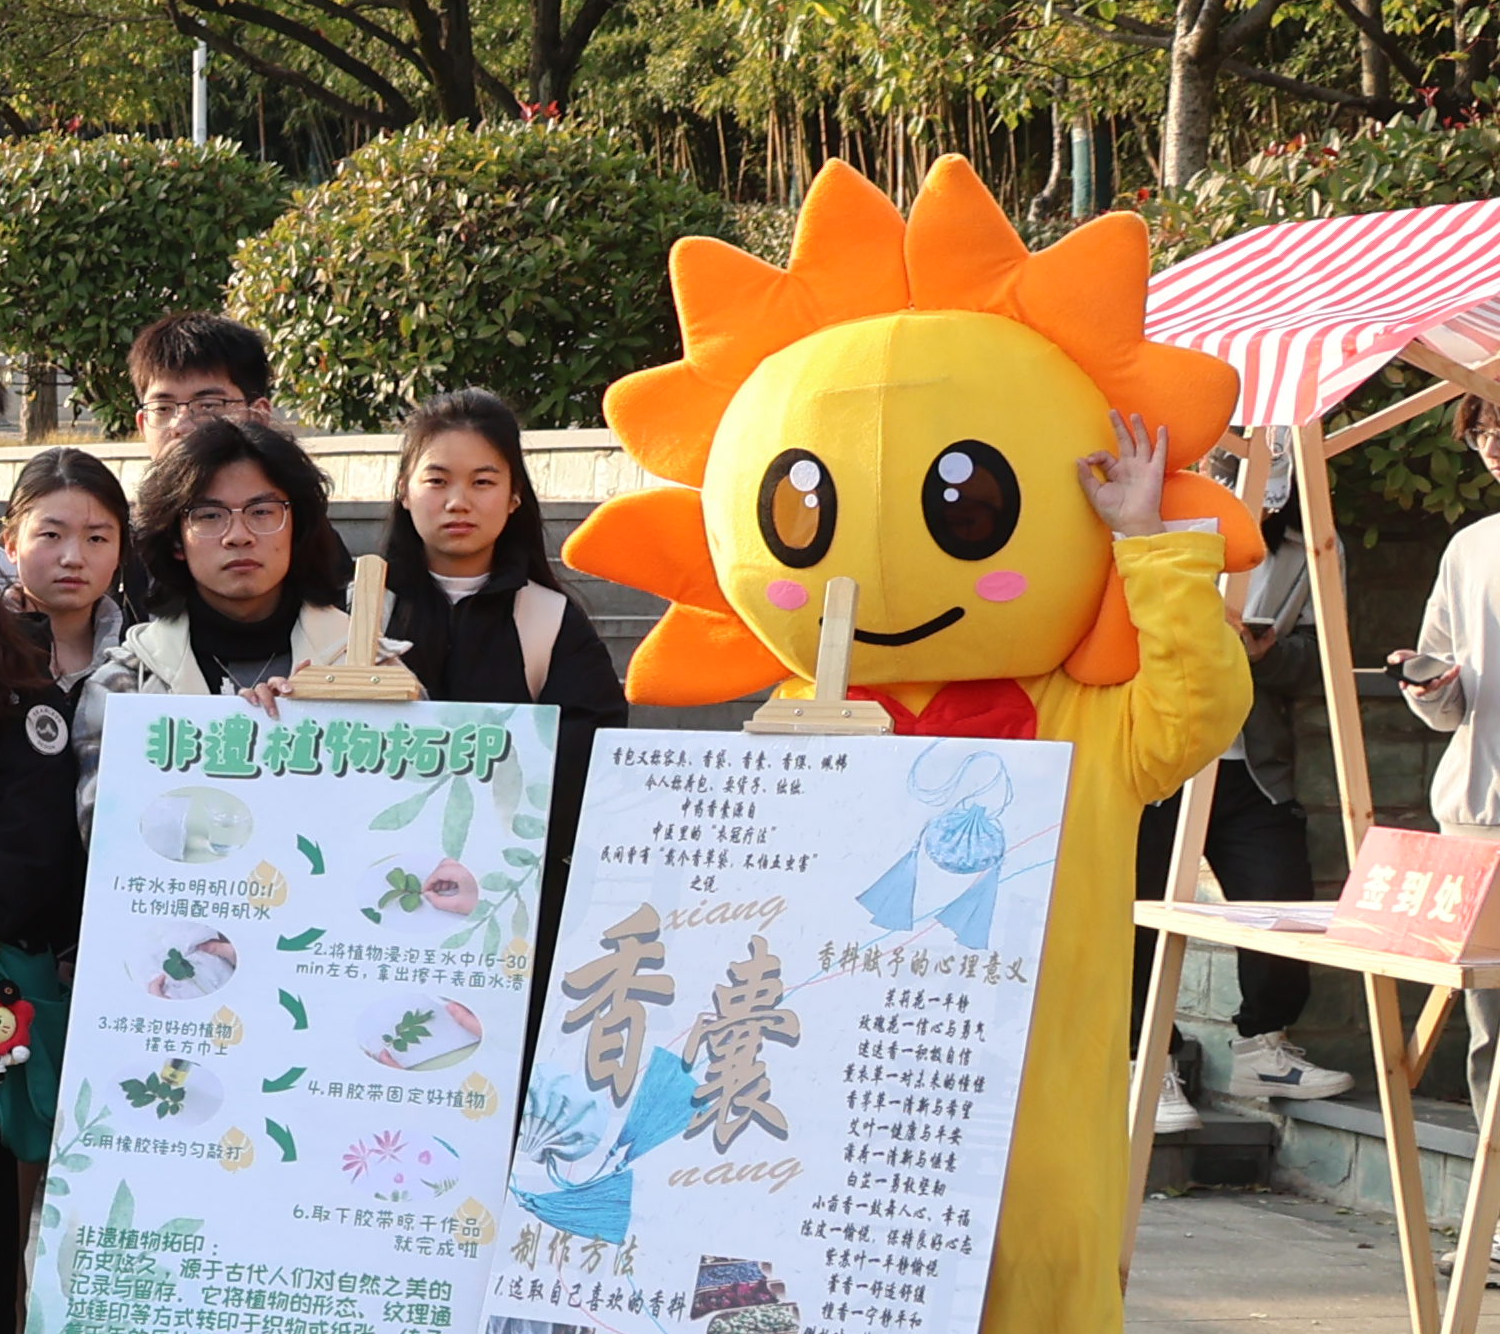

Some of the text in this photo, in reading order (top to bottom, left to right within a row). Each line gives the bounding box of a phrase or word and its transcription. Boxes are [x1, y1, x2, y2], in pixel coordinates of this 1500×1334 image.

[145, 713, 510, 782] 非遗植物拓印
[131, 898, 271, 920] 比例调配明矾水
[663, 893, 790, 933] xiang
[1355, 864, 1465, 923] 签到处
[560, 902, 802, 1156] 香囊
[668, 1152, 804, 1193] nang
[393, 1234, 480, 1260] 就完成啦
[511, 1222, 640, 1276] 制作方法
